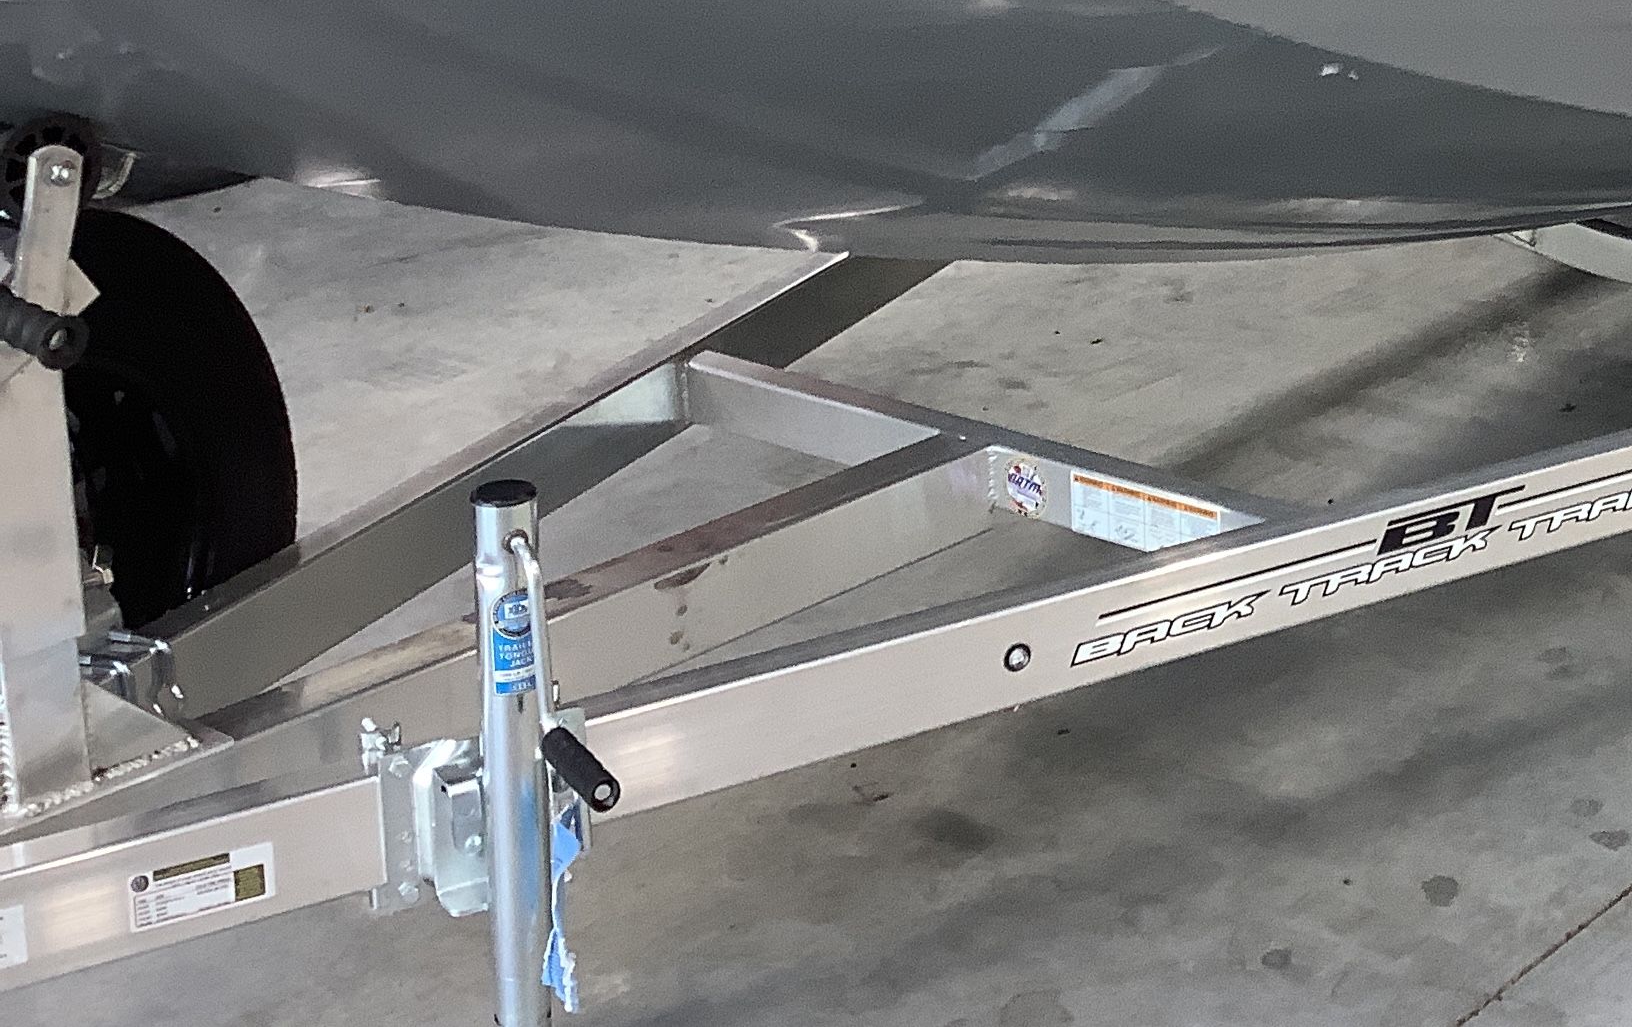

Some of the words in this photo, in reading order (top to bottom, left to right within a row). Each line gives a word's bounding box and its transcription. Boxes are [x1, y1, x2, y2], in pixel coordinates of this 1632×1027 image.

[1377, 484, 1526, 556] BT
[1071, 589, 1272, 668] BACK
[1278, 525, 1503, 607] TRACK
